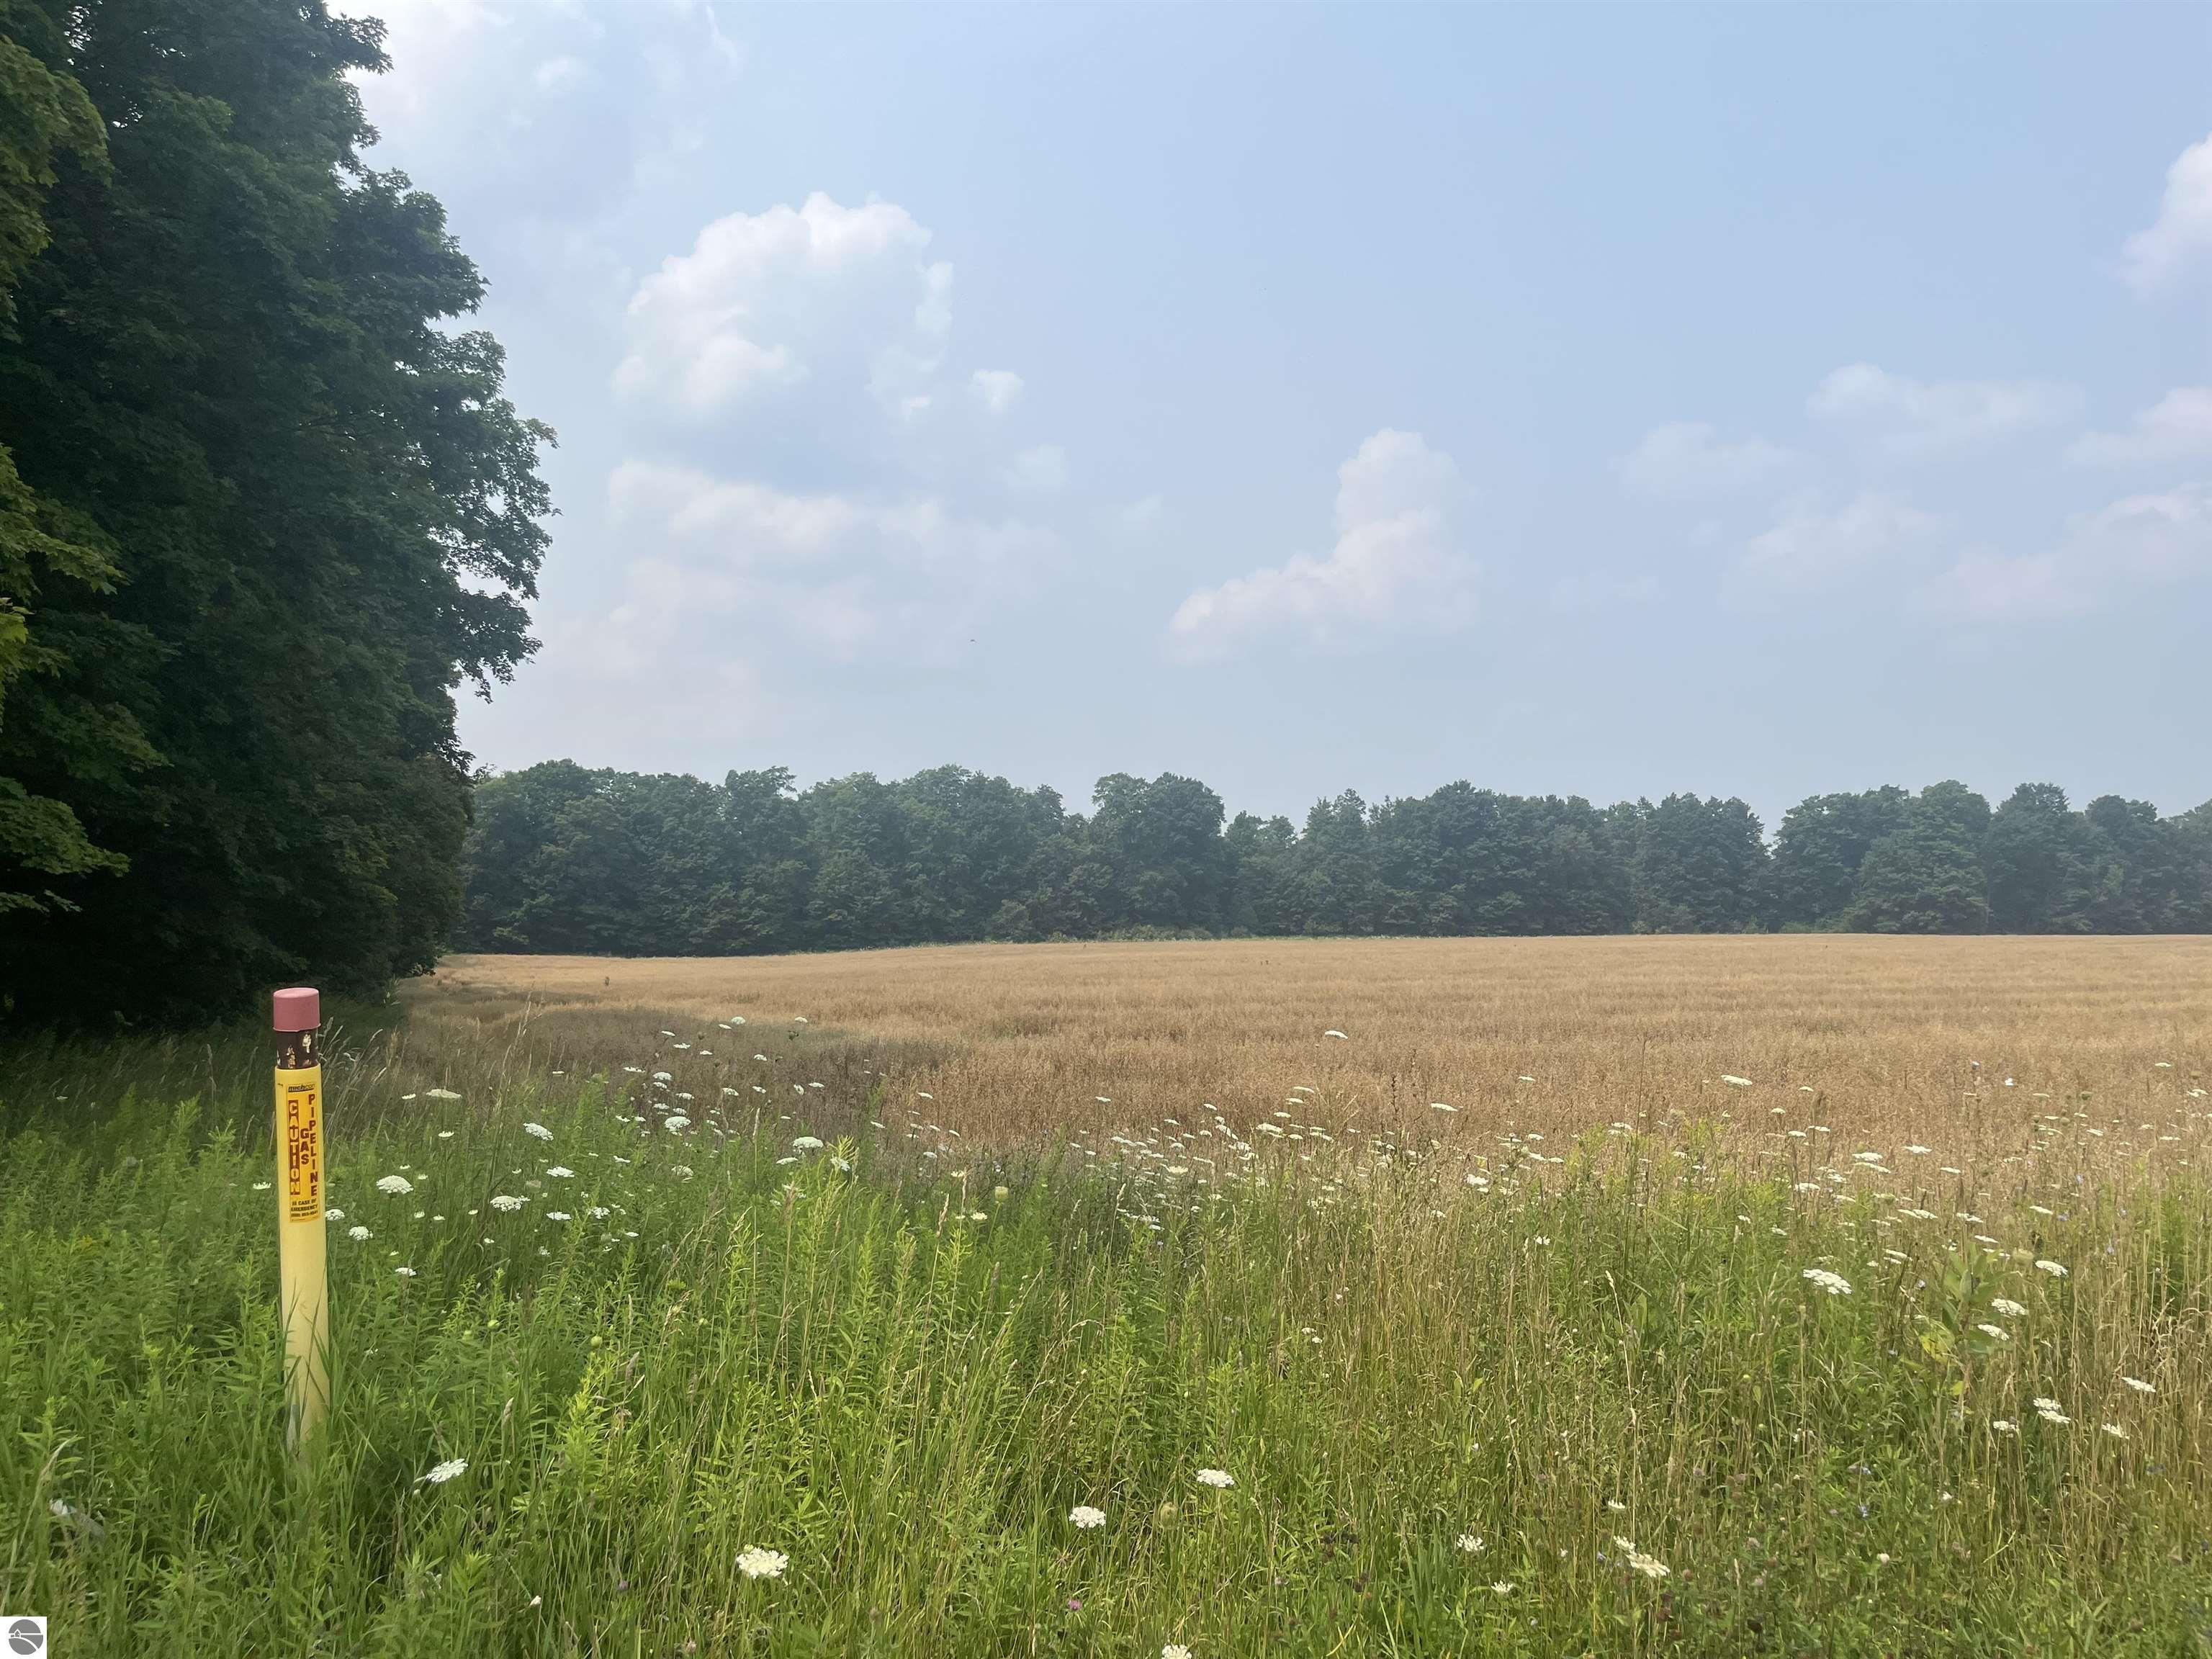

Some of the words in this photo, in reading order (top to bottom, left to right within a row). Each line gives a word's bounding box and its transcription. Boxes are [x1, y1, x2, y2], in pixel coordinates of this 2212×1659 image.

[289, 1101, 300, 1193] CAUTION
[300, 1128, 309, 1164] GAS
[308, 1094, 318, 1195] PIPELINE
